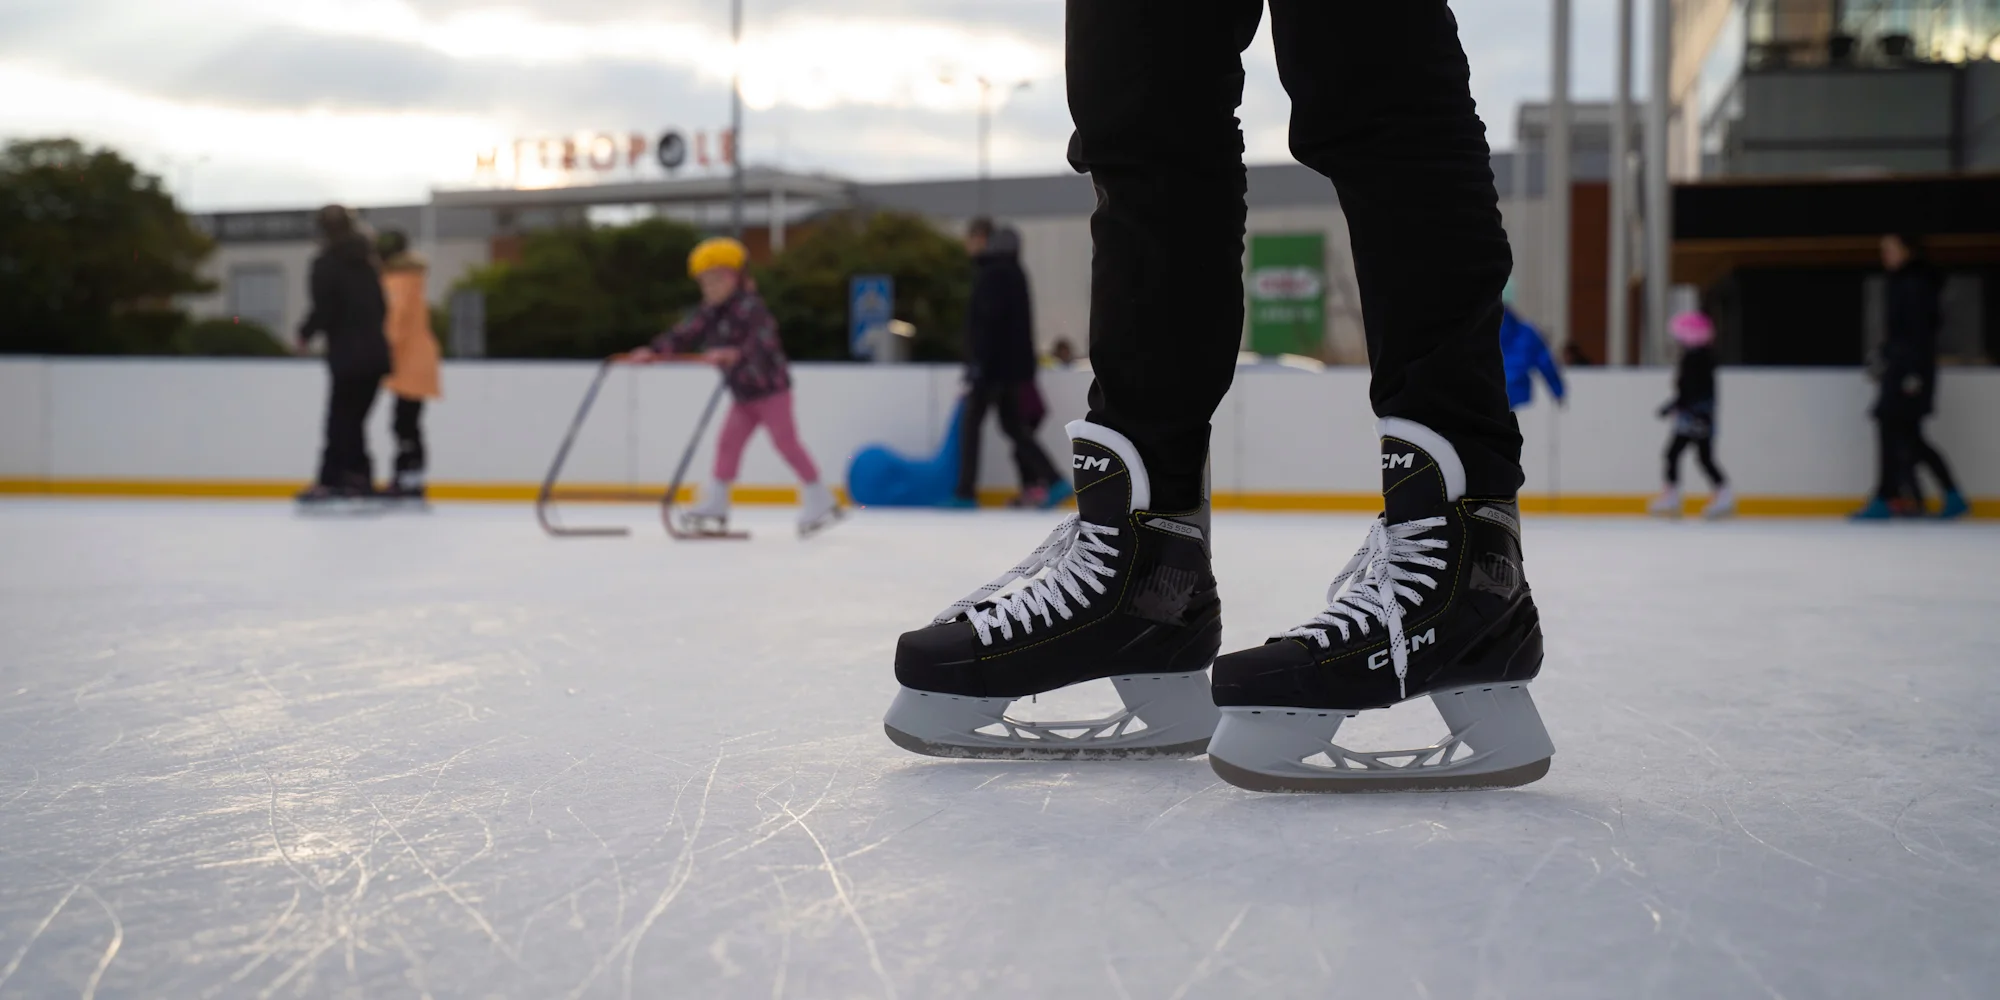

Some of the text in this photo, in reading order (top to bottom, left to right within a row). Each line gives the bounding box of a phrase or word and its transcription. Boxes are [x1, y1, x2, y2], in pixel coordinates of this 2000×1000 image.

[1500, 515, 1514, 526] 550
[1158, 521, 1193, 534] AS 550
[1367, 627, 1436, 671] CM
